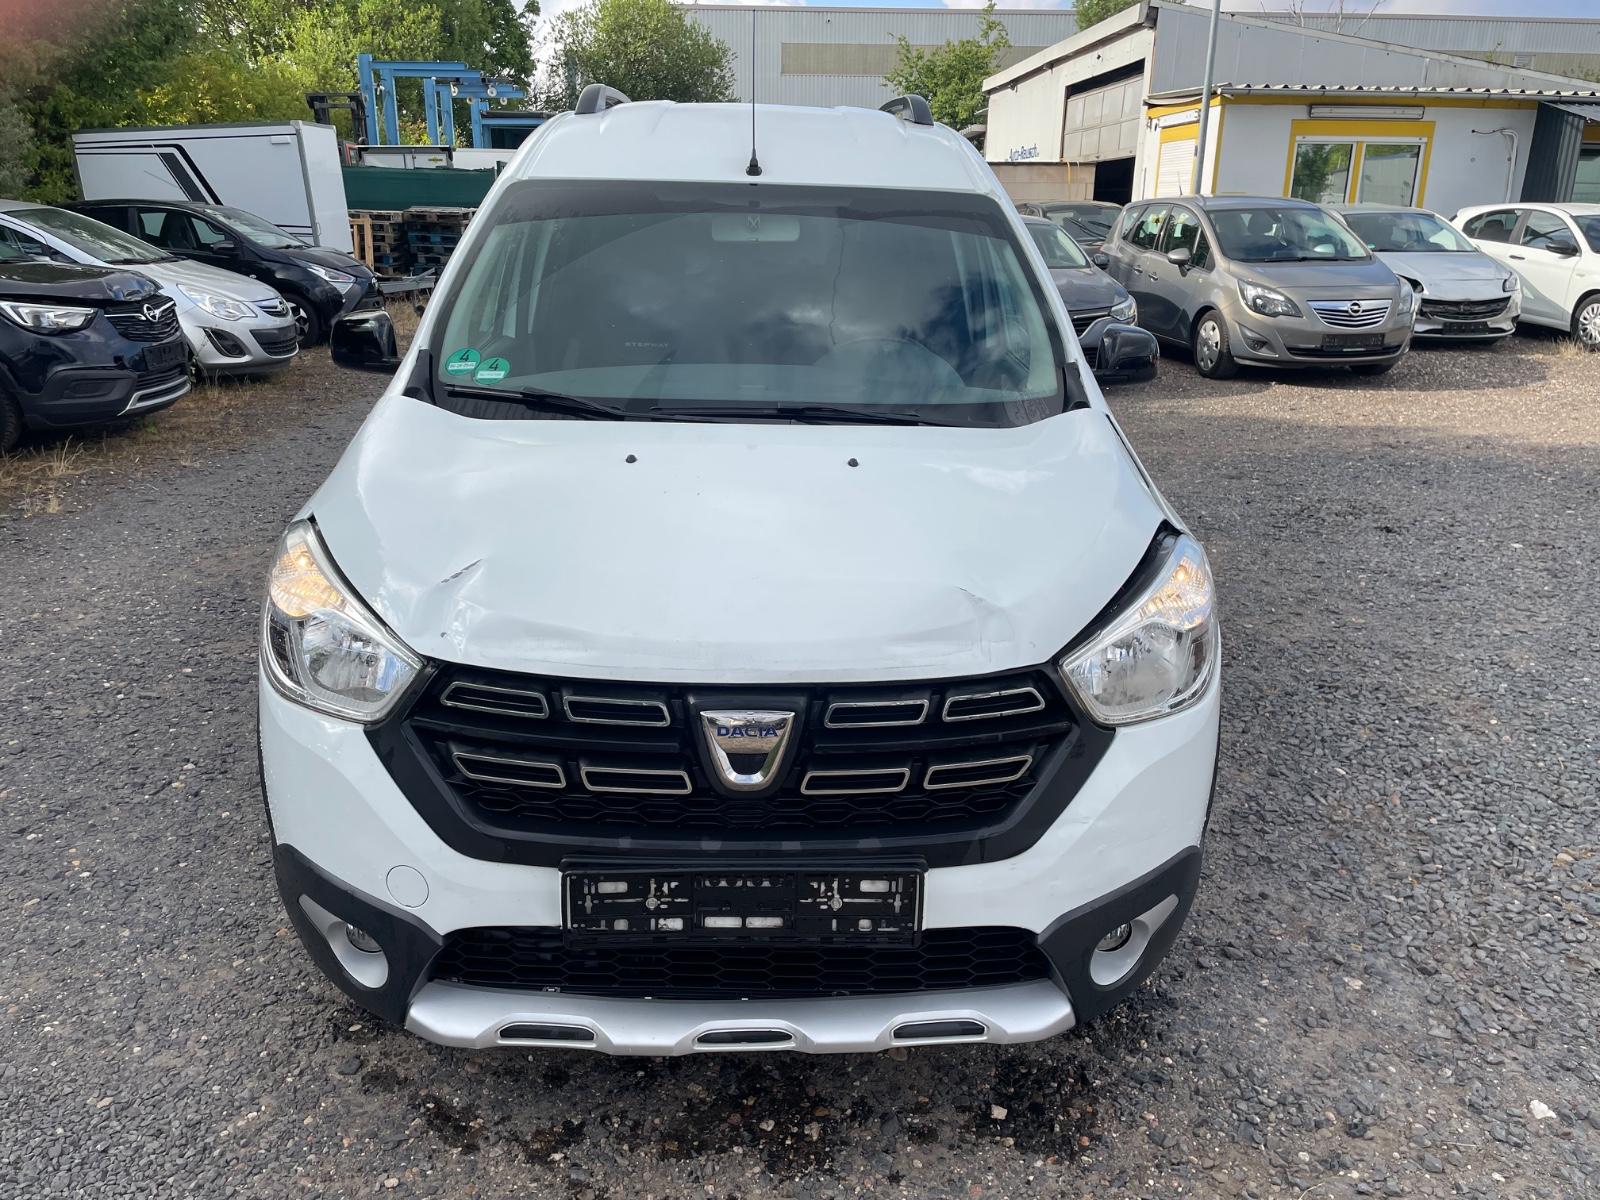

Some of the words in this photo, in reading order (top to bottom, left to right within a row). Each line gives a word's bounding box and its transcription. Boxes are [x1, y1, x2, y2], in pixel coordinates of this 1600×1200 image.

[460, 349, 470, 361] 4
[489, 358, 500, 371] 4
[716, 726, 778, 737] DACIA
